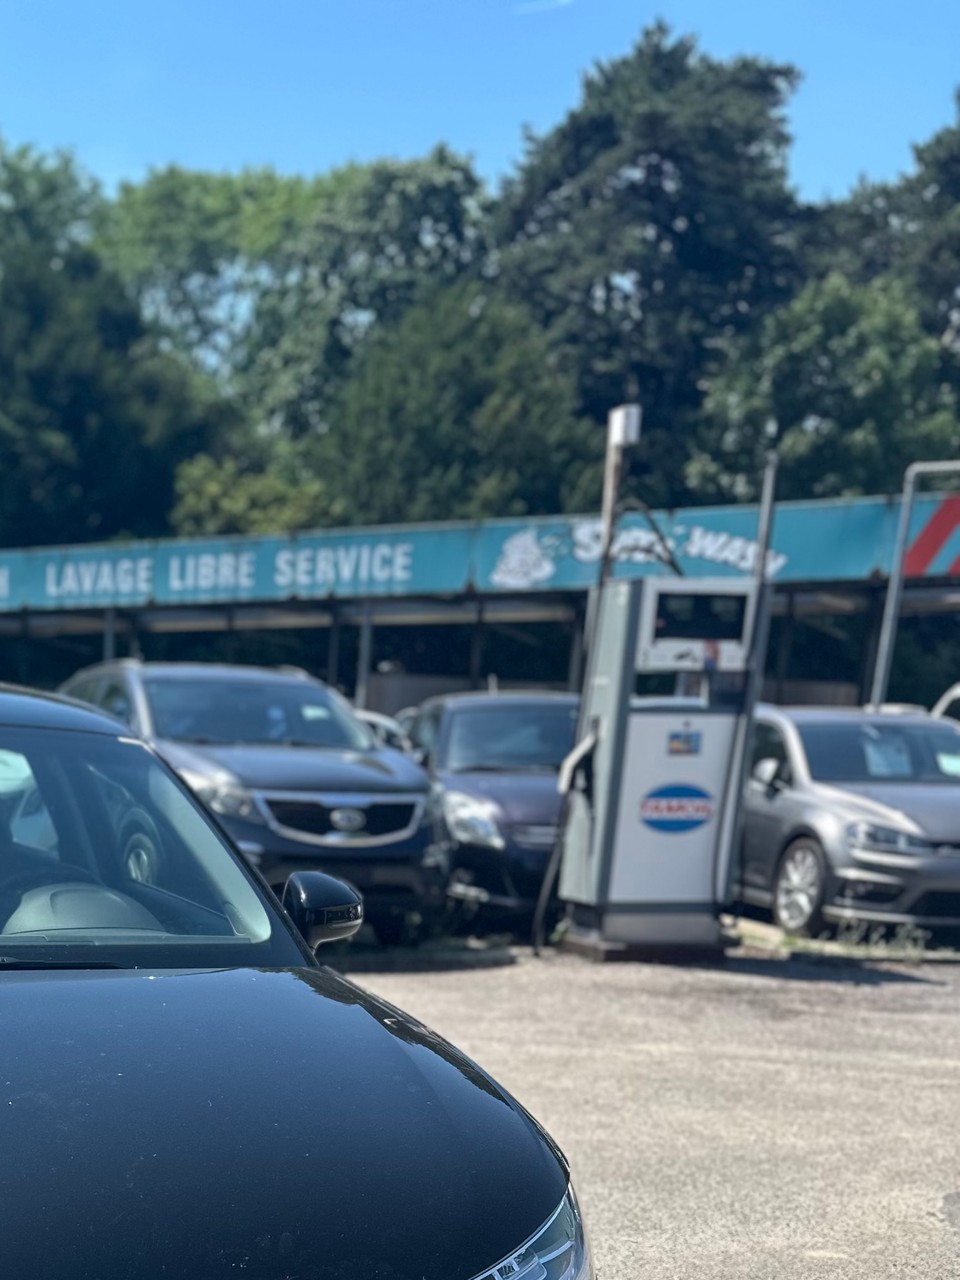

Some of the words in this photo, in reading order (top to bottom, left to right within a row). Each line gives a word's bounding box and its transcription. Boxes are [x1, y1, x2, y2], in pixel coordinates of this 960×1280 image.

[45, 557, 154, 597] LAVAGE
[169, 551, 255, 591] LIBRE
[274, 543, 413, 587] SERVICE
